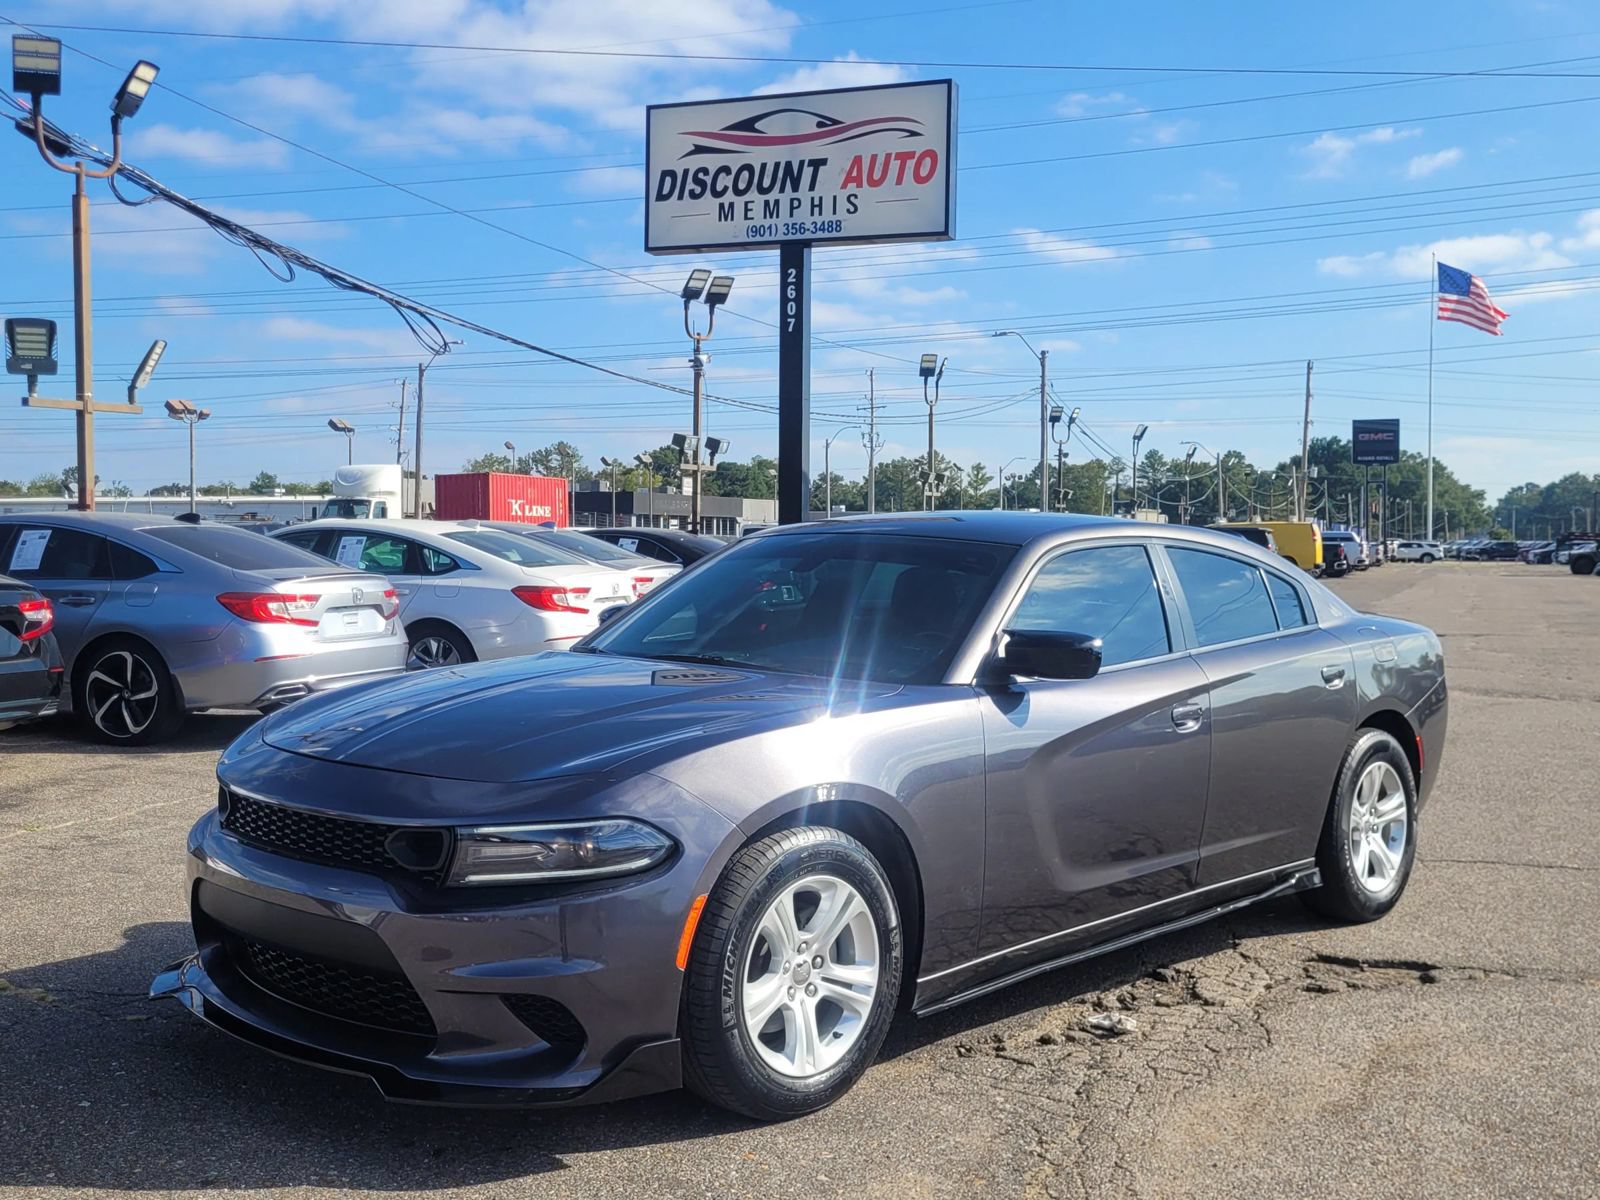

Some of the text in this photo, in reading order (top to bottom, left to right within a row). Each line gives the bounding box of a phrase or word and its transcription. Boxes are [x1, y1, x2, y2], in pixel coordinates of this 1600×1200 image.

[655, 149, 938, 202] DISCOUNT AUTO
[718, 193, 859, 222] MEMPHIS
[746, 220, 842, 239] (901) 356-3488
[787, 268, 797, 332] 2607
